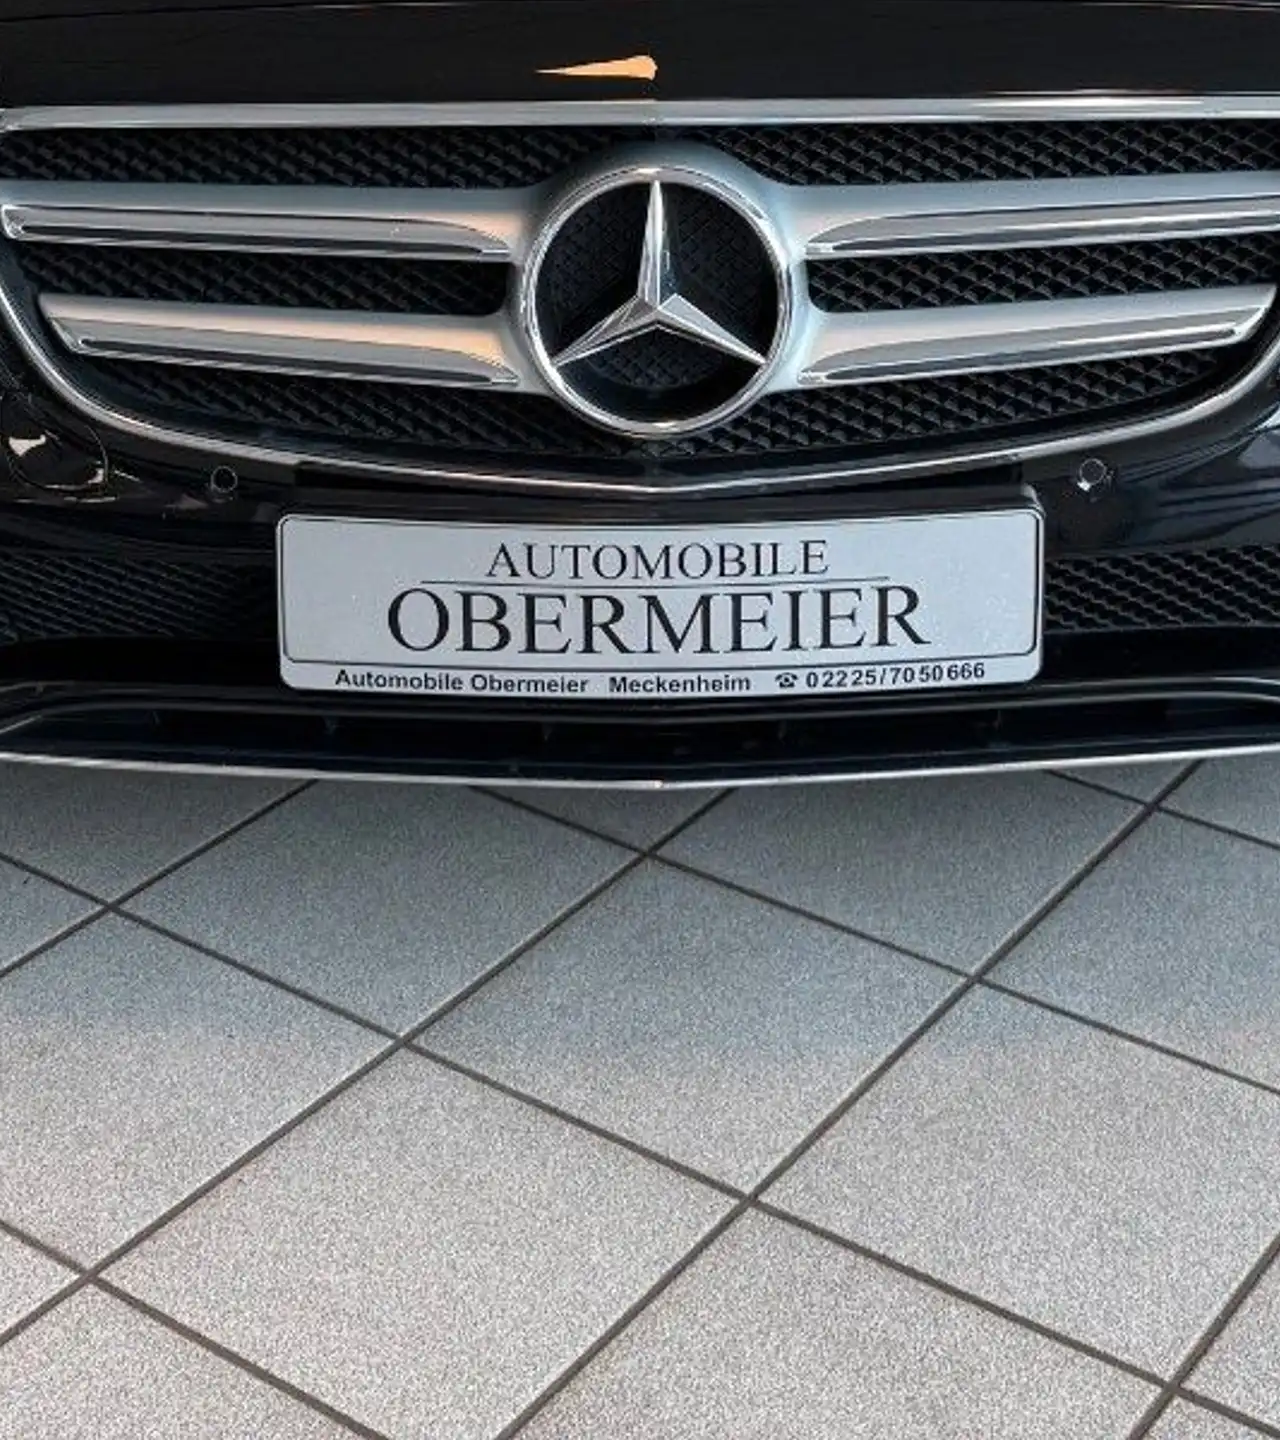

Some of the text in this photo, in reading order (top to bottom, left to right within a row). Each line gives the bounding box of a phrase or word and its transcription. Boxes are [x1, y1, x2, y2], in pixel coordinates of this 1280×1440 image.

[485, 539, 829, 580] AUTOMOBILE
[387, 584, 932, 655] OBERMEIER
[335, 668, 464, 692] Automobile
[470, 673, 589, 694] Obermeier
[608, 675, 751, 694] Meckenheim
